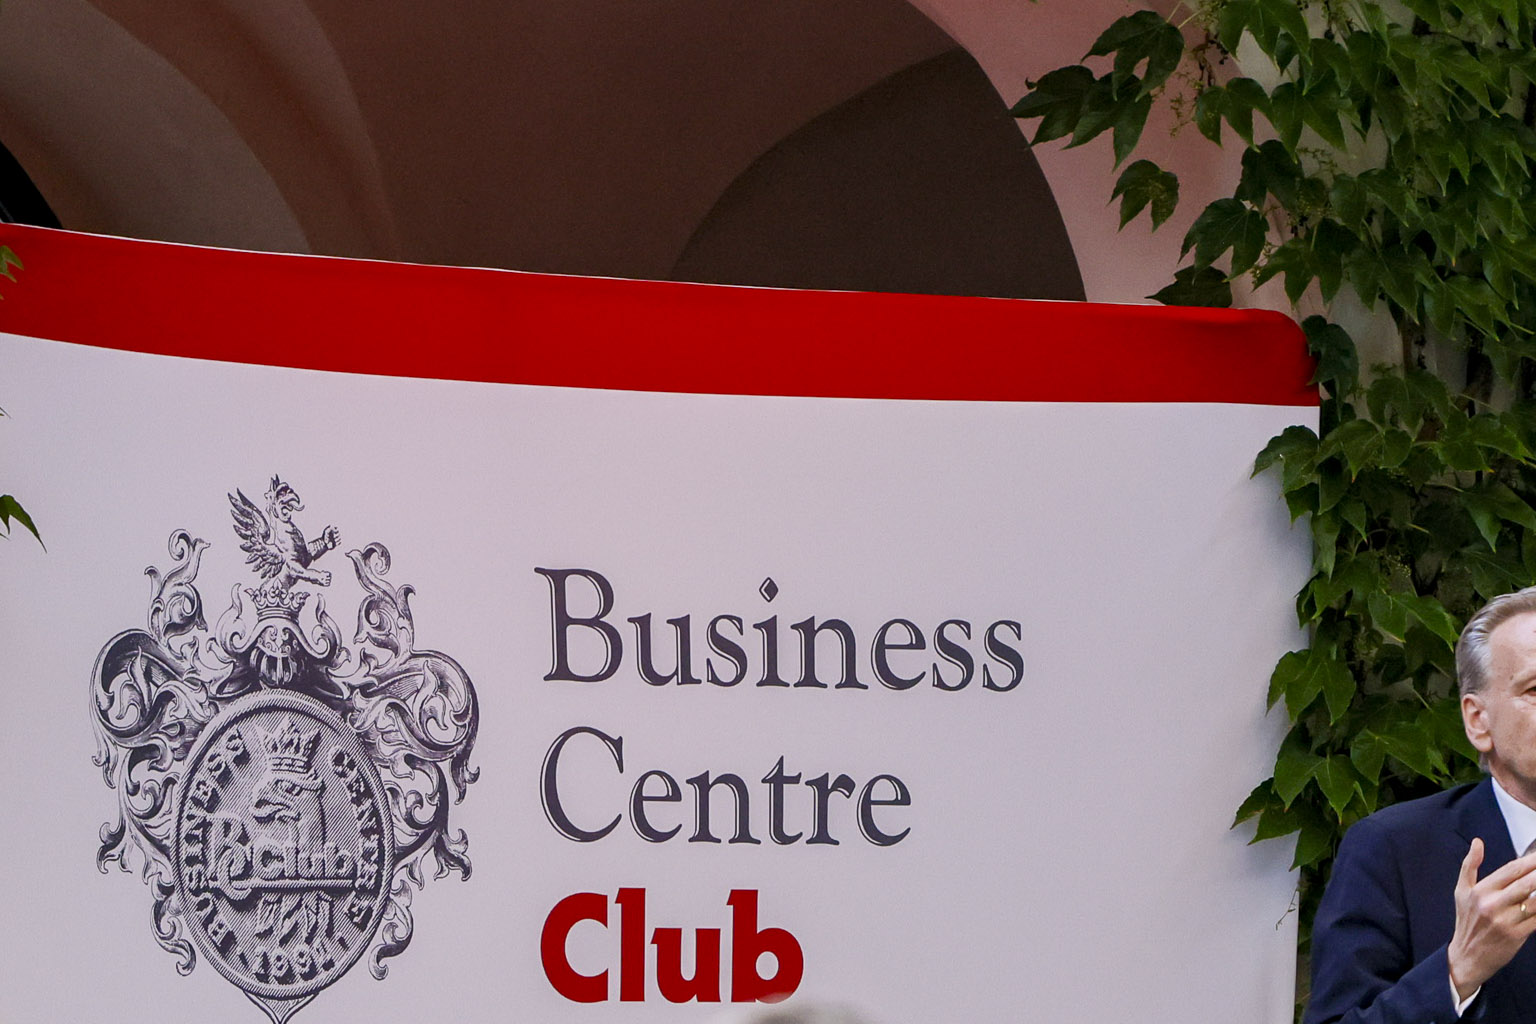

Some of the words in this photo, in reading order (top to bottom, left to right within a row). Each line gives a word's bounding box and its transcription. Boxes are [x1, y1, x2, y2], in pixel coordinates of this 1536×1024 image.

[534, 567, 1024, 692] Business
[540, 726, 911, 847] Centre
[540, 887, 804, 1004] Club
